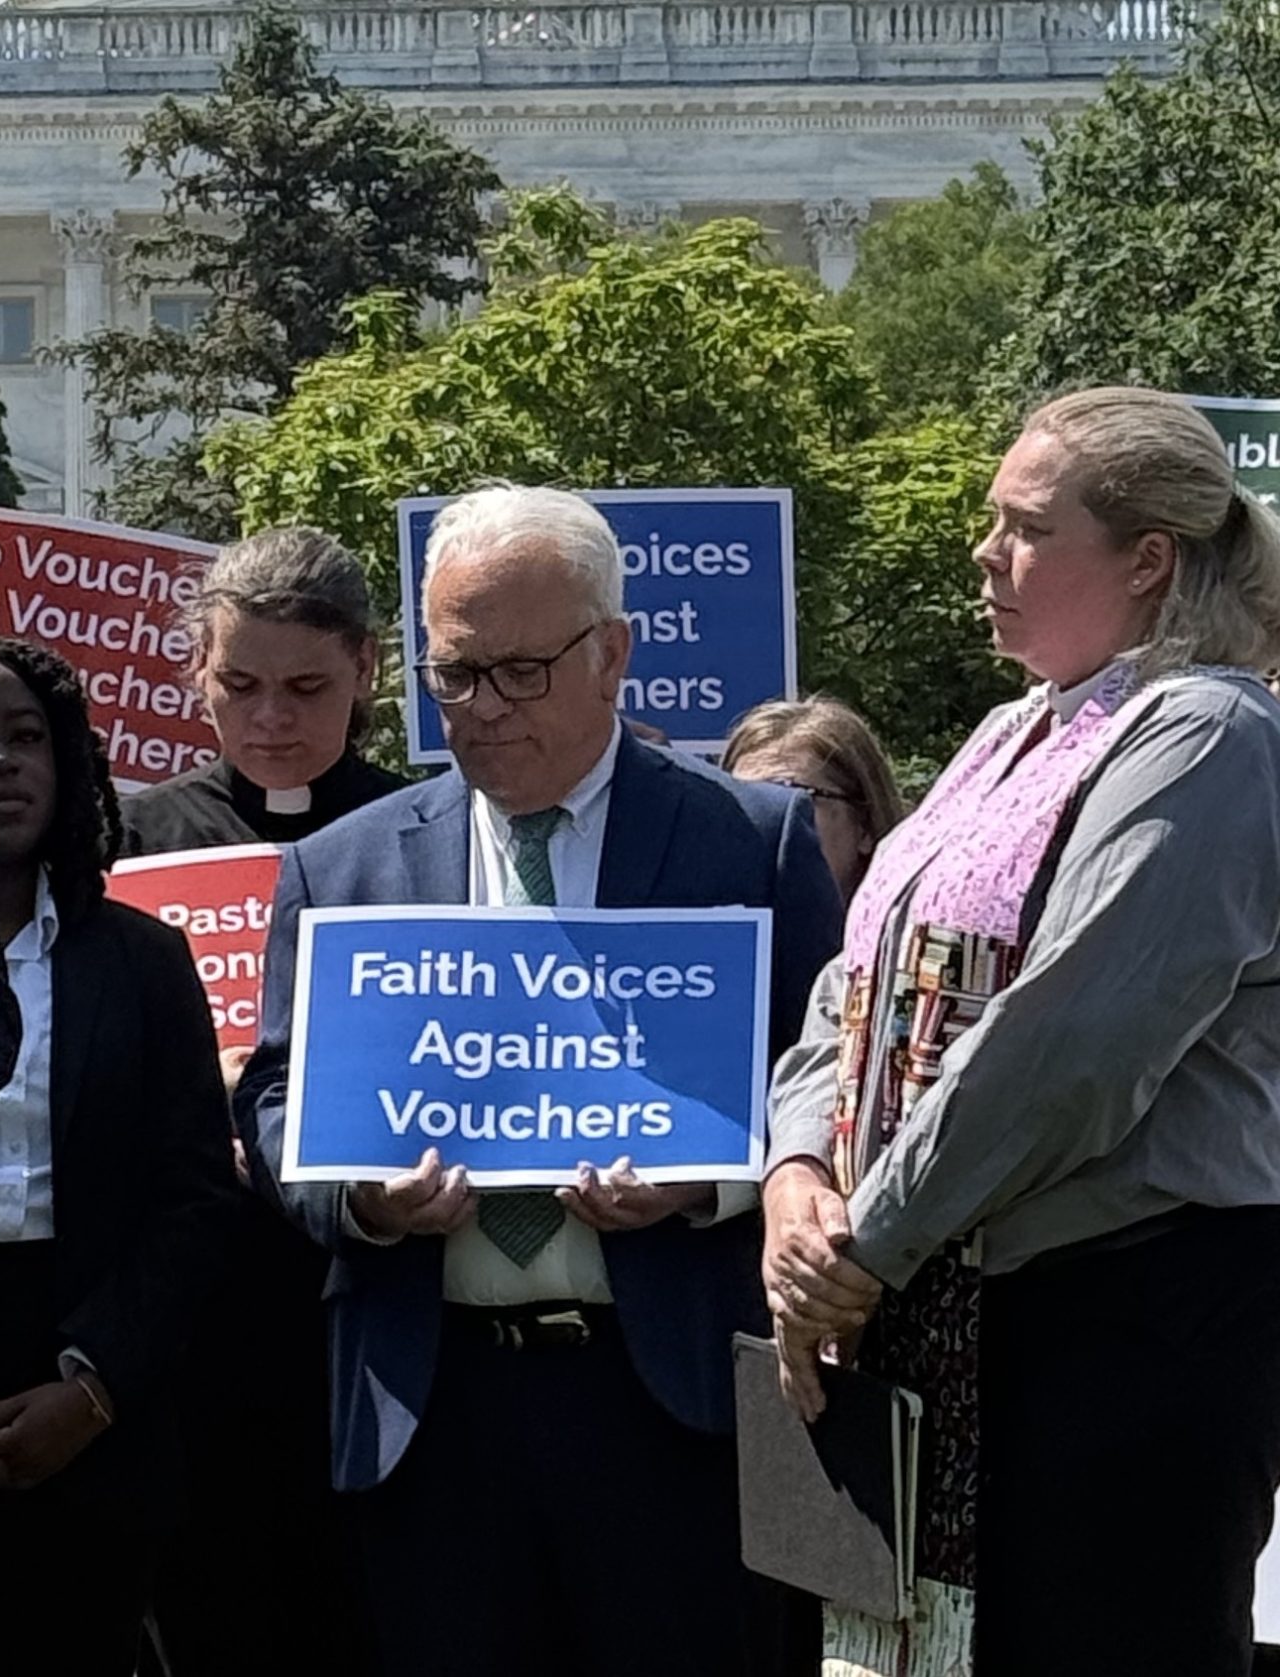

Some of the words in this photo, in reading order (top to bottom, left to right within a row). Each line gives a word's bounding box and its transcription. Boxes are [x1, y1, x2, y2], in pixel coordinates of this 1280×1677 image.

[16, 535, 199, 607] Vouche
[619, 532, 751, 576] oices
[7, 589, 192, 662] Vouche
[78, 665, 216, 727] cher
[616, 677, 724, 711] hers
[91, 719, 218, 774] hers
[159, 897, 273, 936] Past
[196, 951, 266, 983] on
[349, 950, 497, 998] Faith
[511, 952, 717, 1000] Voices
[207, 990, 263, 1030] Sc
[409, 1019, 647, 1080] Against
[377, 1089, 673, 1140] Vouchers
